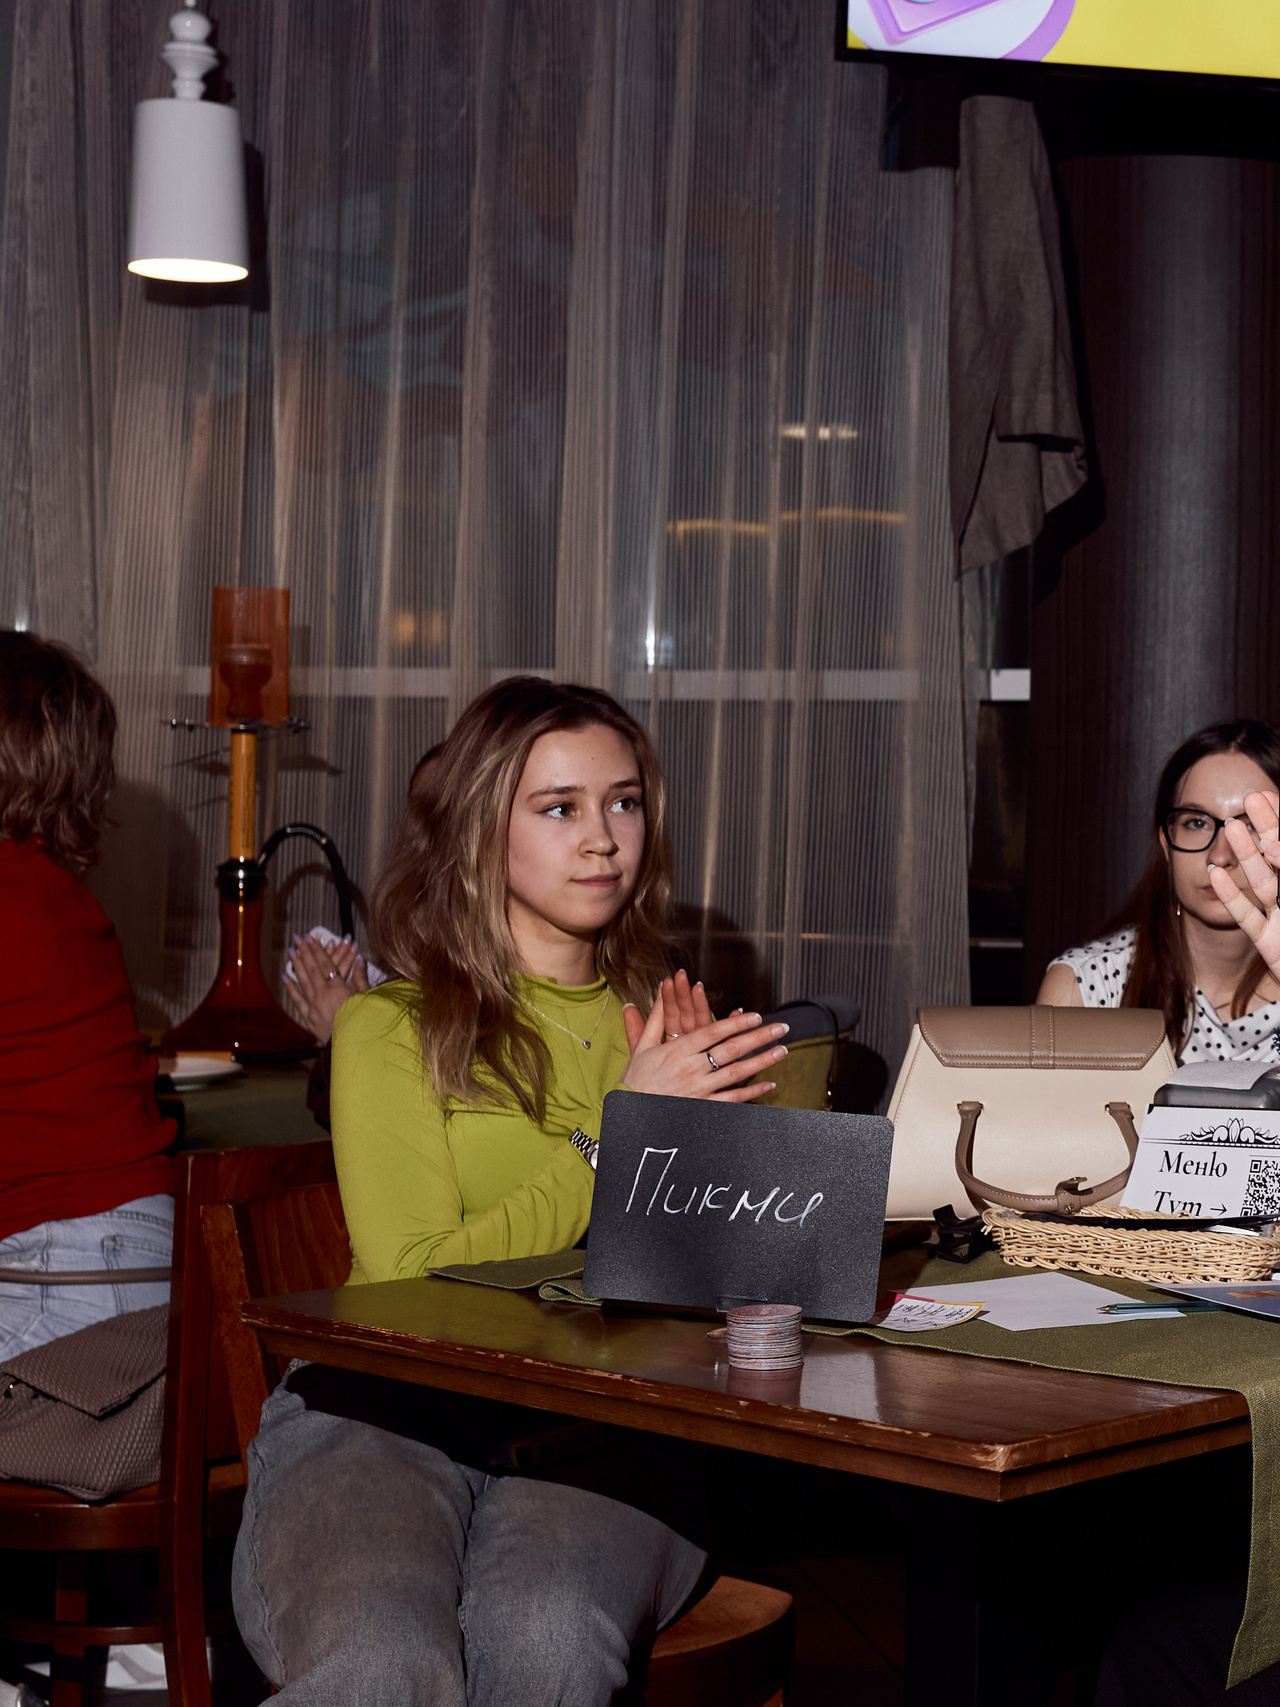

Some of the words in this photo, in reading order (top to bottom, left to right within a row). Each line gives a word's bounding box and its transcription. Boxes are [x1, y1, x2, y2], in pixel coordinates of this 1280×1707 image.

[1158, 1150, 1228, 1178] Меню
[625, 1147, 824, 1229] Пикми
[1153, 1190, 1202, 1217] Тут
